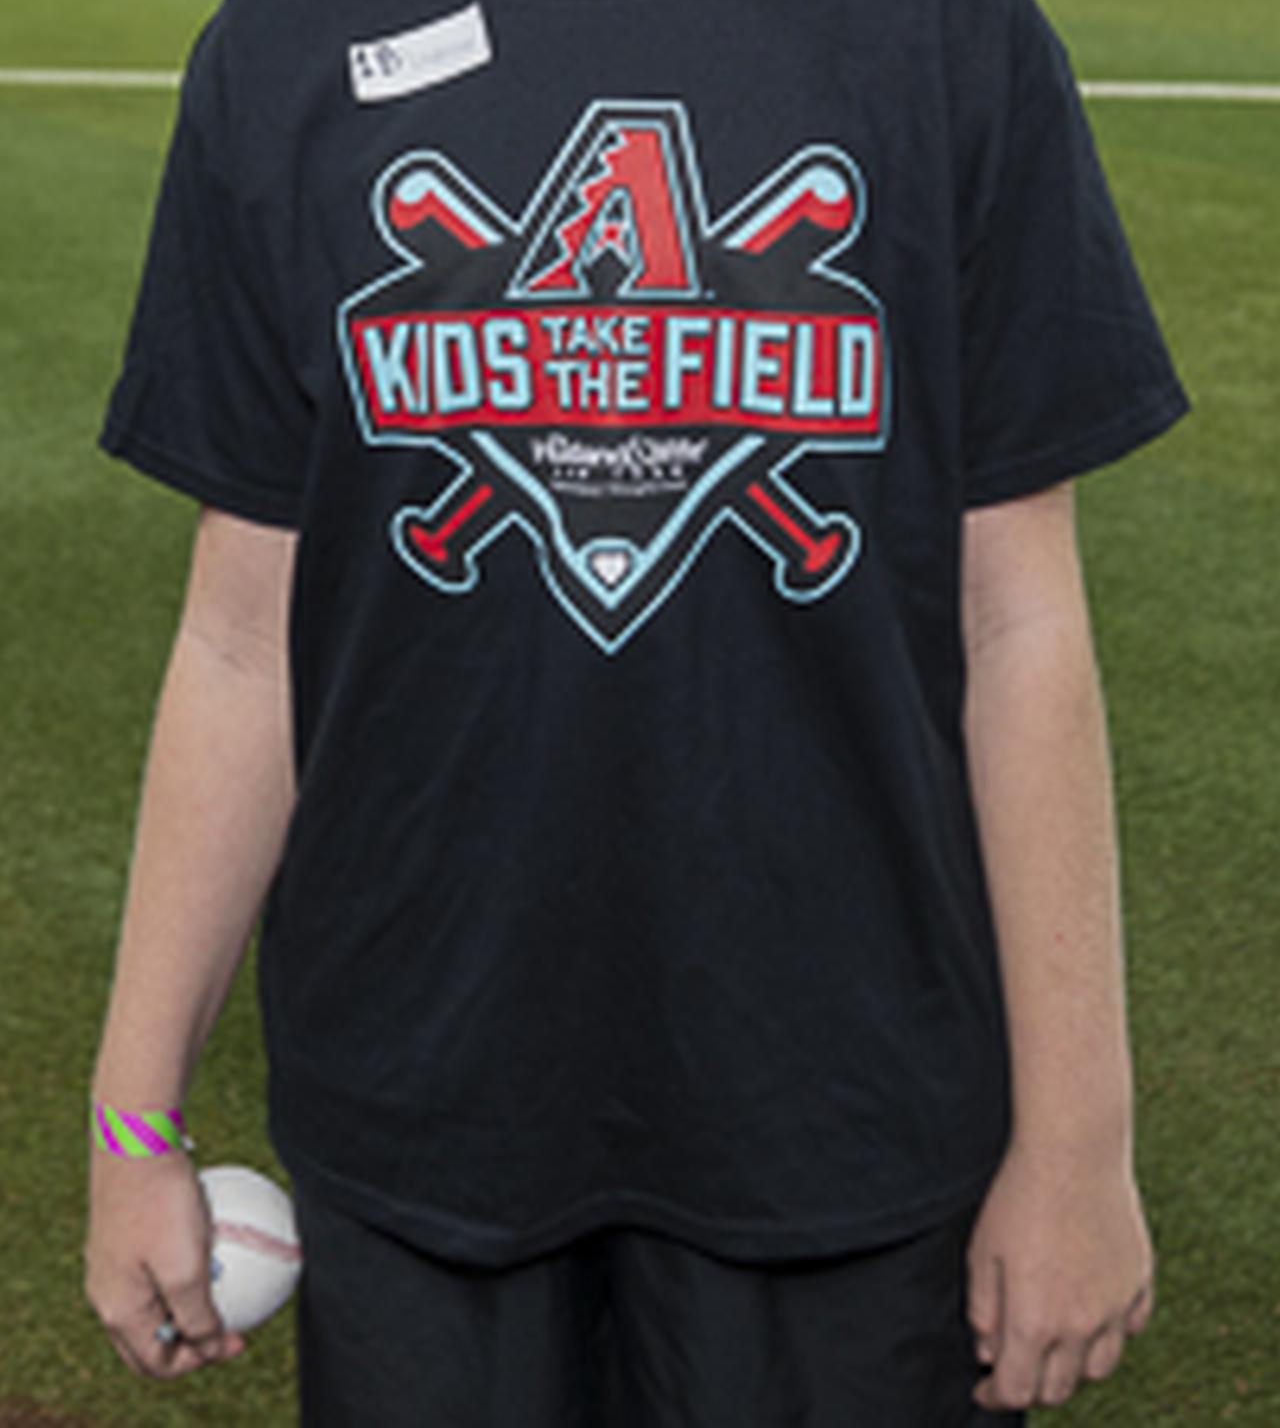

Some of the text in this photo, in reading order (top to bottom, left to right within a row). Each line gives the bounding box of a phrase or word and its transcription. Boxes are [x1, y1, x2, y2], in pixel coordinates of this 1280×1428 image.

[361, 316, 877, 418] KIDS TAKE FIELD
[544, 361, 651, 412] THE
